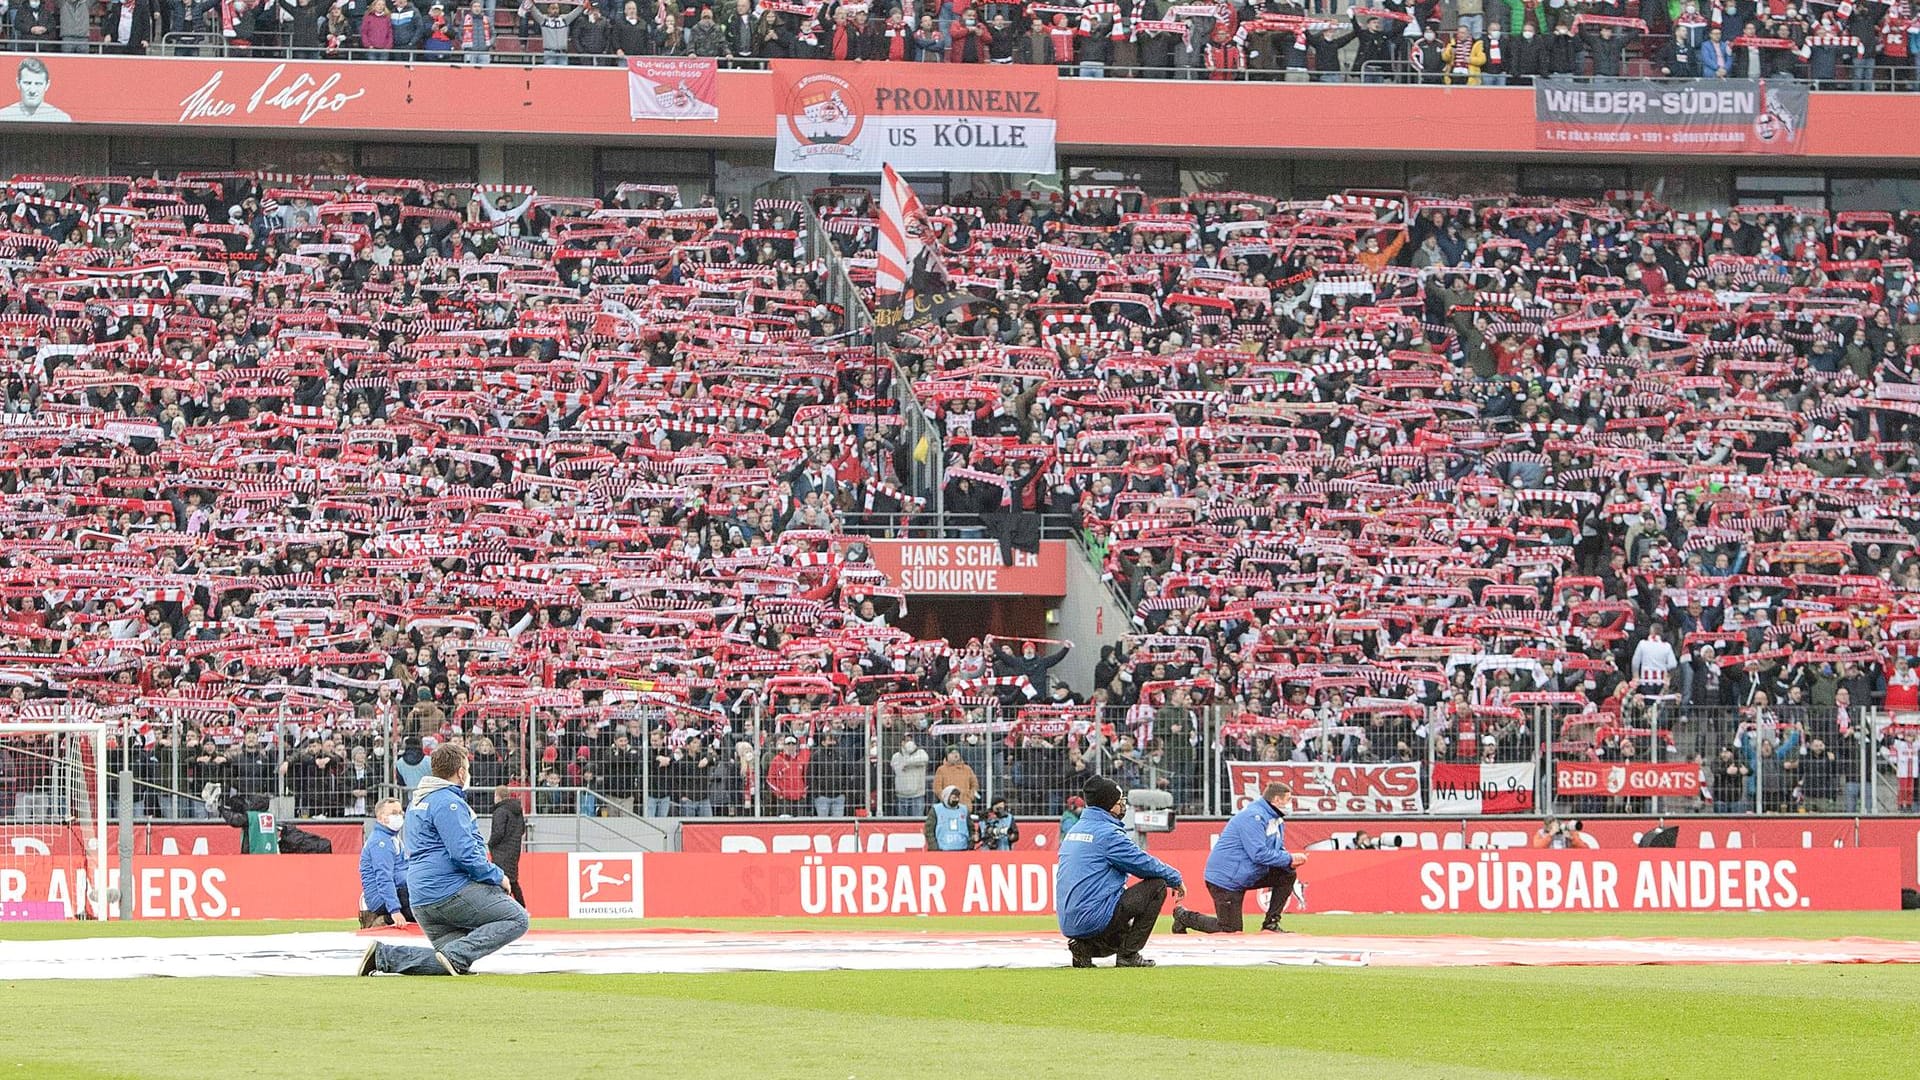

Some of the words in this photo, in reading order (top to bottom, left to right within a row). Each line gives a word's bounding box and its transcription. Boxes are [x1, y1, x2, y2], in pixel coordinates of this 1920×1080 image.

[875, 87, 1043, 113] PROMINENZ
[1544, 87, 1754, 114] WILDER-SÜDEN
[934, 118, 1028, 148] KÖLLE
[901, 545, 949, 567] HANS
[955, 541, 1038, 567] SCHÄER
[901, 566, 998, 591] SÜDKURVE
[1231, 765, 1419, 797] FREAKS
[1432, 780, 1458, 800] NA
[1464, 781, 1499, 801] UND
[1507, 776, 1527, 803] 98
[1558, 770, 1598, 788] RED
[1629, 771, 1698, 789] GOATS
[1237, 797, 1418, 813] CLOGNE
[962, 863, 1058, 913] AND
[1420, 852, 1619, 910] SPÜRBAR
[1633, 859, 1810, 909] ANDERS.
[578, 906, 634, 915] BUNDESLIGA
